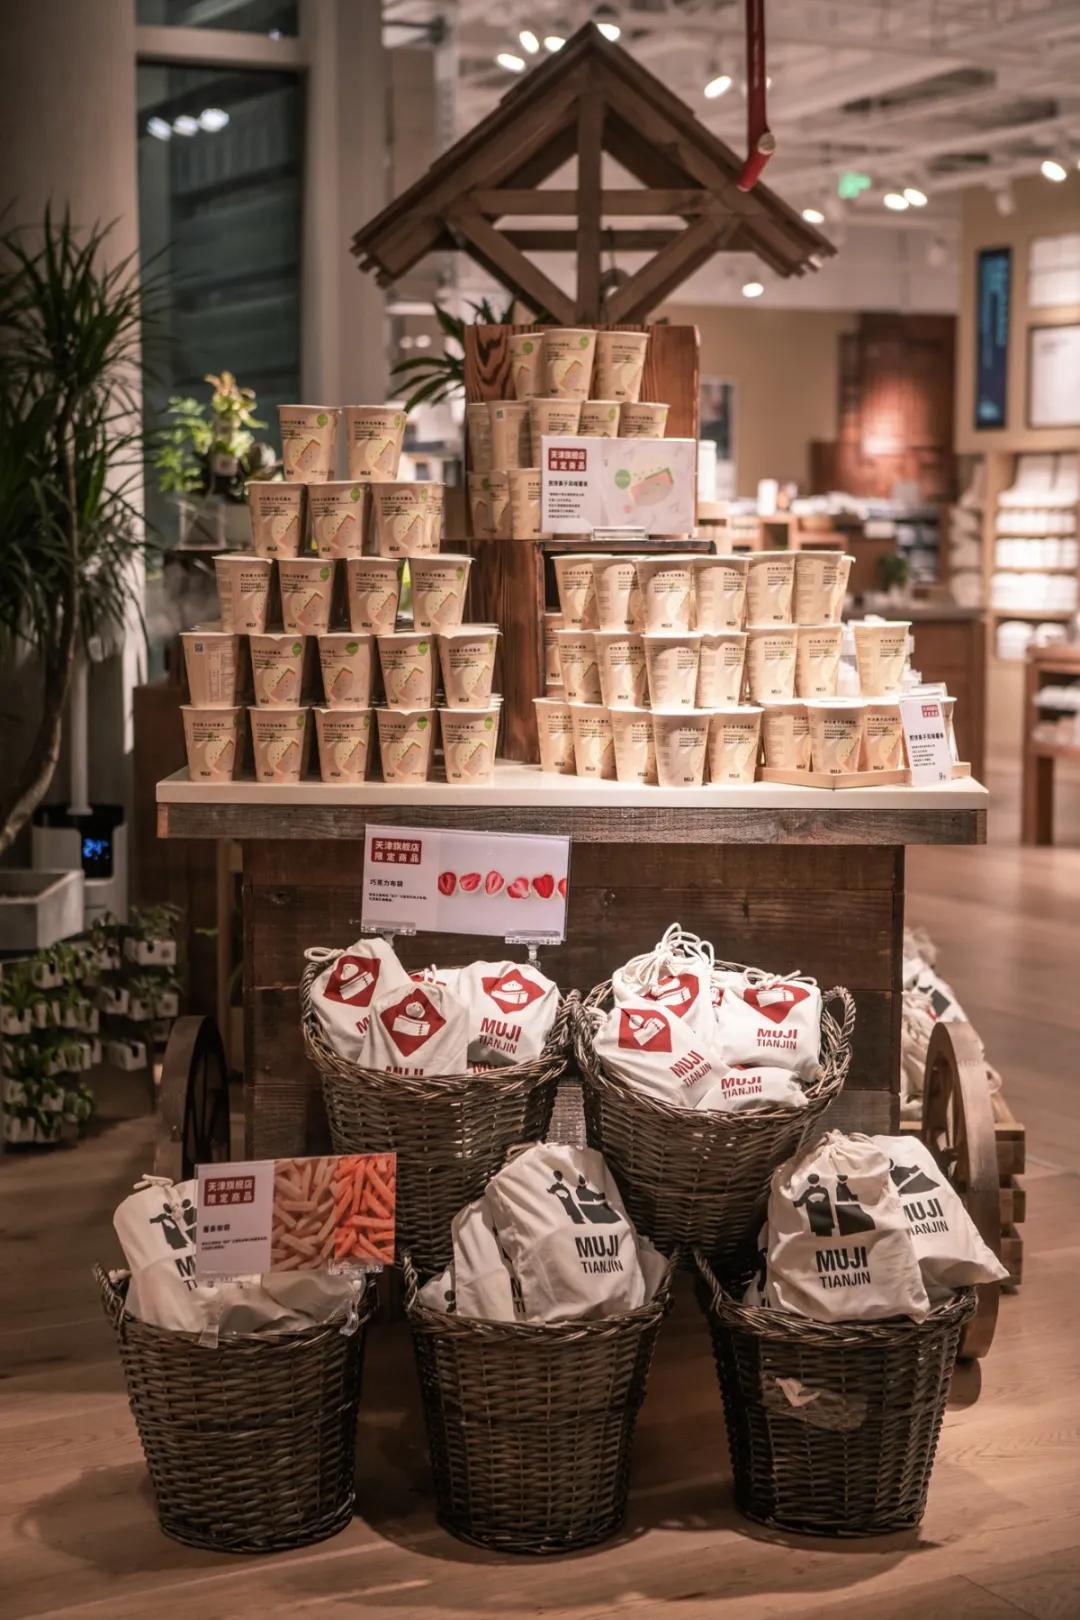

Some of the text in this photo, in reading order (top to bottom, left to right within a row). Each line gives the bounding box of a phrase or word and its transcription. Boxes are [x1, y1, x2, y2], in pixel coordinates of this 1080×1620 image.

[375, 841, 420, 852] 天津旗舰店
[374, 852, 420, 863] 限定商品
[481, 1018, 522, 1042] MUJI
[757, 1028, 798, 1039] MUJI
[480, 1035, 517, 1054] TIANJIN
[757, 1039, 797, 1050] TIANJIN
[670, 1050, 704, 1078] MUJI
[683, 1062, 712, 1087] TIANJIN
[721, 1076, 762, 1090] MUJI
[723, 1085, 762, 1100] TIANJIN
[208, 1180, 252, 1191] 天津旗舰店
[207, 1191, 252, 1204] 限定商品
[575, 1235, 619, 1258] MUJI
[816, 1246, 868, 1273] MUJI
[581, 1260, 623, 1274] TIANJIN
[819, 1271, 871, 1289] TIANJIN
